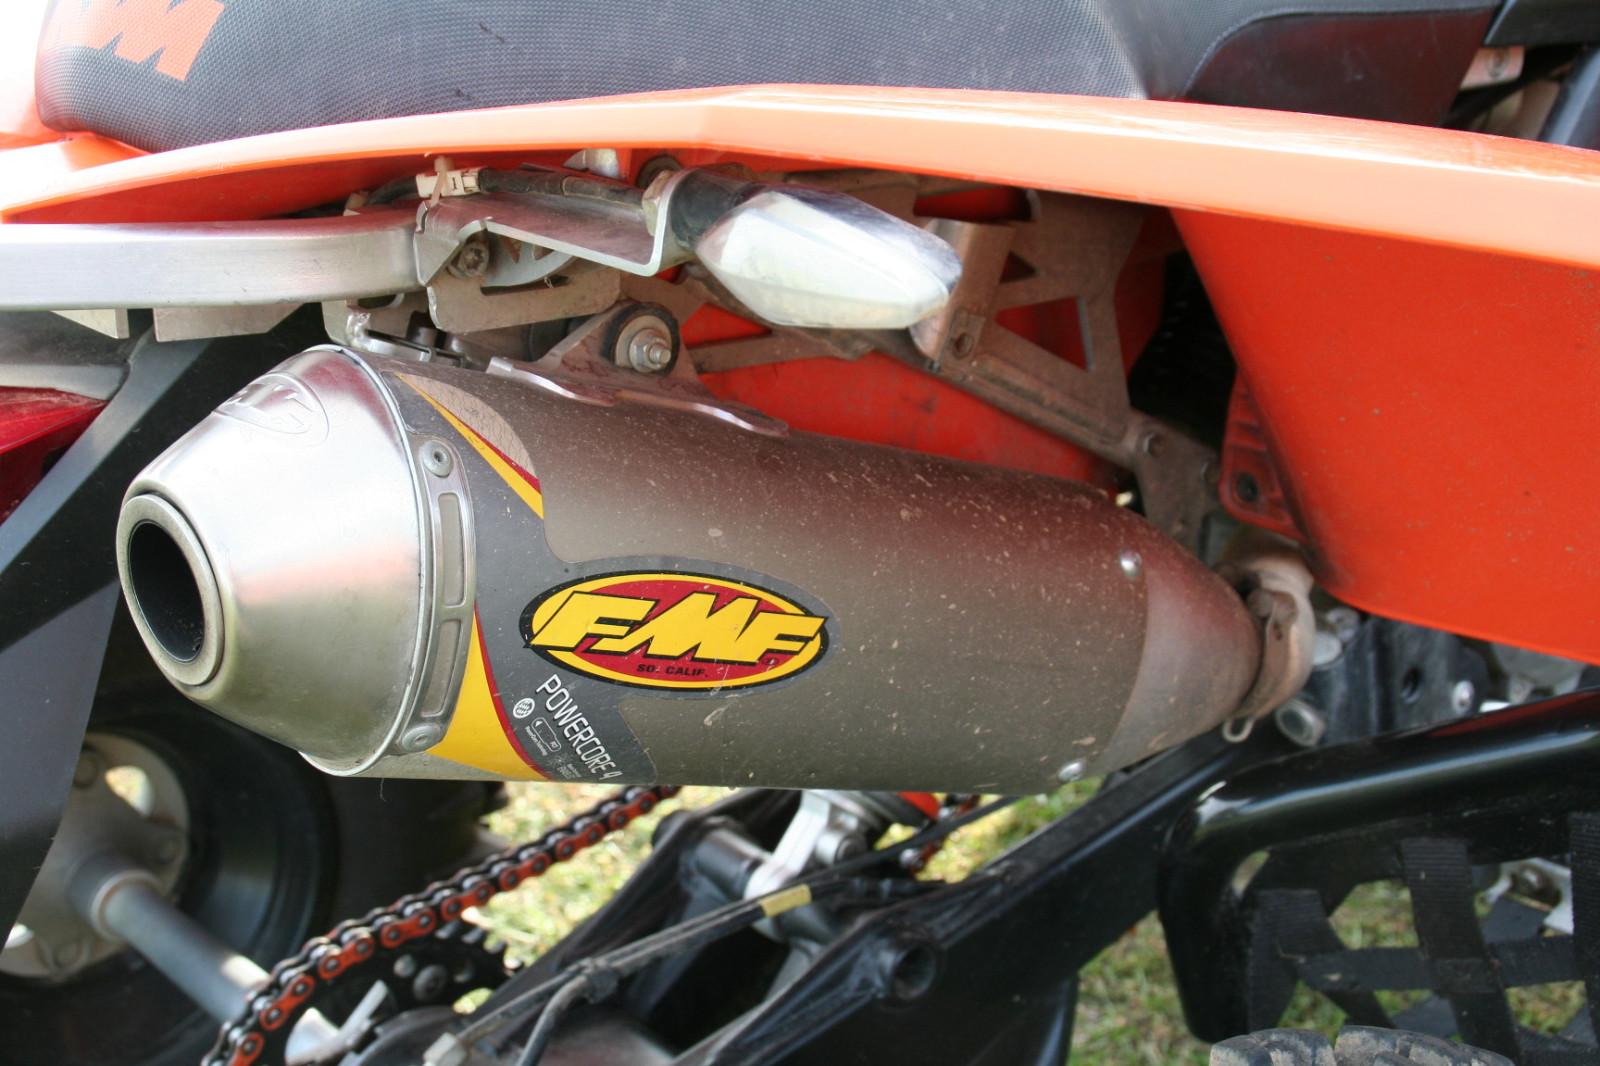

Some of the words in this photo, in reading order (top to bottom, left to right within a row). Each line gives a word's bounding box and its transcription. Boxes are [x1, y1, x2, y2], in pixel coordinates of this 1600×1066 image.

[524, 591, 828, 666] FMF
[665, 665, 709, 678] CALIF.
[535, 673, 617, 774] POWERCORE
